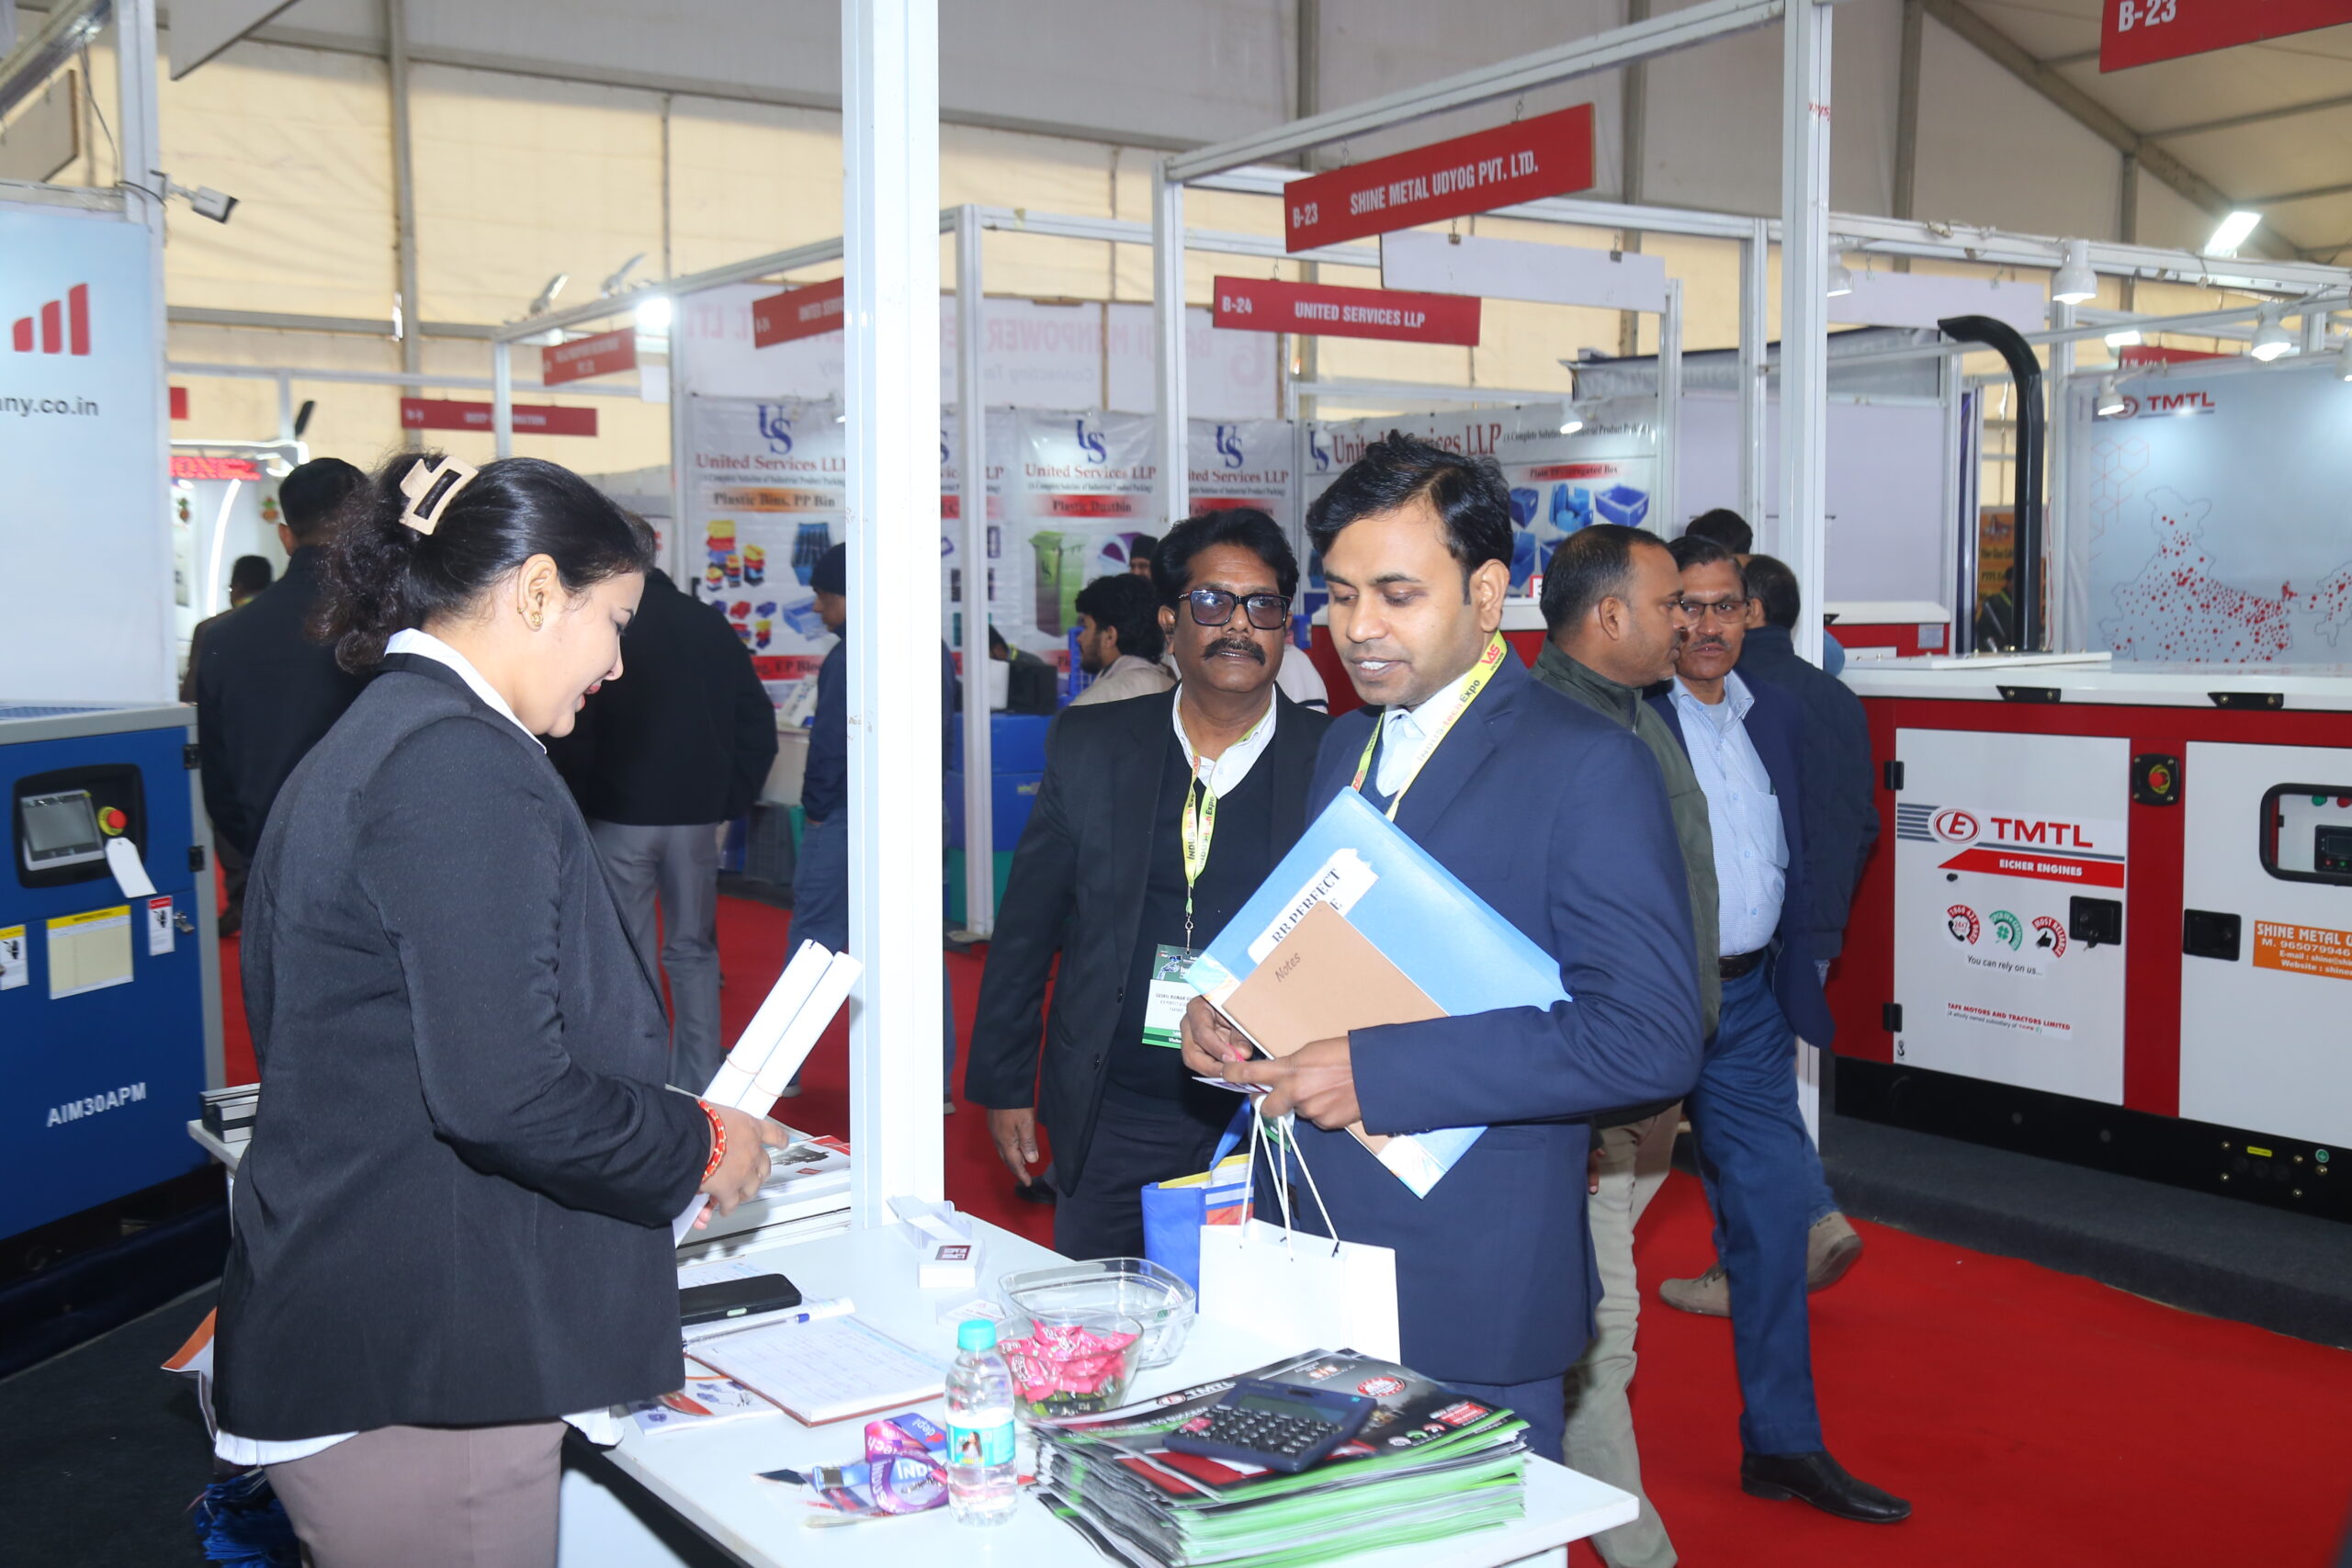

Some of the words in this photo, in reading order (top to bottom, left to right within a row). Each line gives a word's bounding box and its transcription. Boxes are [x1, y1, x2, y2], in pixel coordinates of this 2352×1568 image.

[2119, 0, 2177, 32] B-23
[1292, 202, 1319, 229] B-23
[1350, 187, 1386, 215] SHINE
[1388, 179, 1430, 207] METAL
[1432, 164, 1476, 197] UDYOG
[1477, 157, 1508, 186] PVT.
[1510, 150, 1540, 177] LTD.
[1221, 296, 1253, 314] B-24
[1295, 301, 1340, 321] UNITED
[1342, 304, 1402, 326] SERVICES
[1404, 311, 1426, 328] LLP
[0, 395, 100, 418] ny.co.in
[2146, 391, 2216, 412] TMTL
[1464, 423, 1502, 457] LLP
[695, 453, 751, 471] United
[753, 455, 817, 473] Services
[1024, 463, 1071, 479] United
[1073, 466, 1128, 480] Services
[1131, 467, 1158, 480] LLP
[1212, 469, 1261, 483] Services
[1264, 470, 1289, 484] LLP
[713, 492, 755, 507] Plastic
[1459, 678, 1482, 704] Expo
[1204, 795, 1216, 817] Expo
[1989, 817, 2094, 849] TMTL
[1998, 858, 2035, 873] EICHER
[2036, 862, 2084, 877] ENGINES
[1272, 921, 1293, 943] RR
[1288, 867, 1341, 925] PERFECT
[2256, 922, 2295, 941] SHINE
[2298, 928, 2342, 946] METAL
[2261, 937, 2278, 948] M.
[2279, 939, 2352, 958] 965079946
[2278, 948, 2305, 961] E-mail
[1274, 952, 1302, 983] Notes
[1967, 955, 1982, 965] You
[1983, 959, 1996, 968] can
[1998, 961, 2013, 973] rely
[2014, 964, 2025, 973] on
[2279, 958, 2317, 972] Website
[1962, 1005, 1991, 1017] MOTORS
[1992, 1010, 2007, 1020] AND
[2008, 1013, 2042, 1026] TRACTORS
[2042, 1019, 2071, 1032] LIMITED
[46, 1082, 147, 1128] AIM30APM
